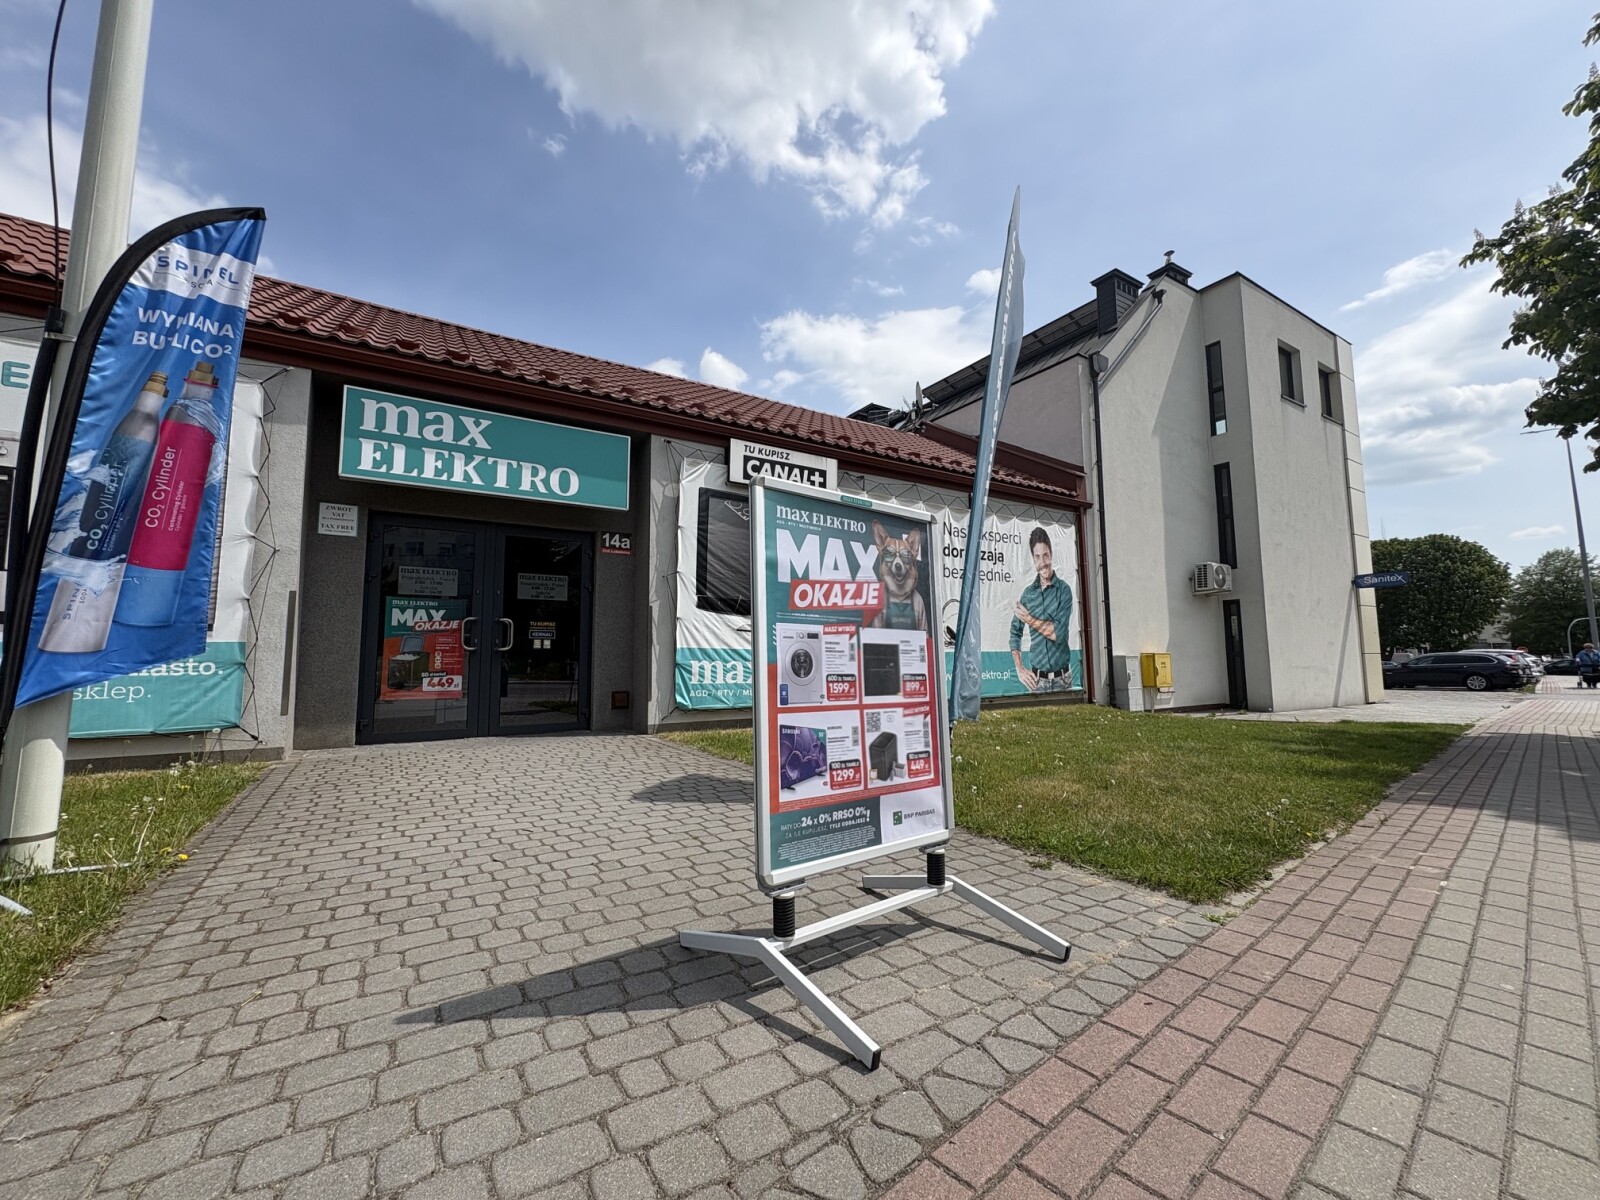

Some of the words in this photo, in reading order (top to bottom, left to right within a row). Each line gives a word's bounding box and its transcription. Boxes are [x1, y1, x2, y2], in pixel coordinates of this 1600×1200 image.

[359, 397, 493, 450] max
[743, 444, 756, 454] TU
[757, 447, 791, 461] KUPISZ
[152, 446, 177, 500] Cylinder
[356, 437, 580, 497] ELEKTRO
[746, 459, 824, 488] CANAL+
[776, 505, 810, 523] max
[812, 512, 867, 534] ELEKTRO
[943, 521, 967, 539] Nas
[981, 530, 1022, 547] ksperci
[602, 532, 631, 549] 14a
[776, 528, 880, 582] MAX
[793, 583, 880, 608] OKAZJE
[391, 608, 446, 626] MAX
[414, 620, 460, 631] OKAZJE
[427, 677, 454, 688] 449
[828, 683, 850, 694] 1599
[689, 689, 709, 697] AGD
[717, 689, 734, 697] RTV
[832, 769, 854, 782] 1299
[801, 816, 813, 827] 24
[818, 813, 832, 824] 0%
[832, 808, 854, 821] RRSO
[915, 808, 936, 818] PARIBAS
